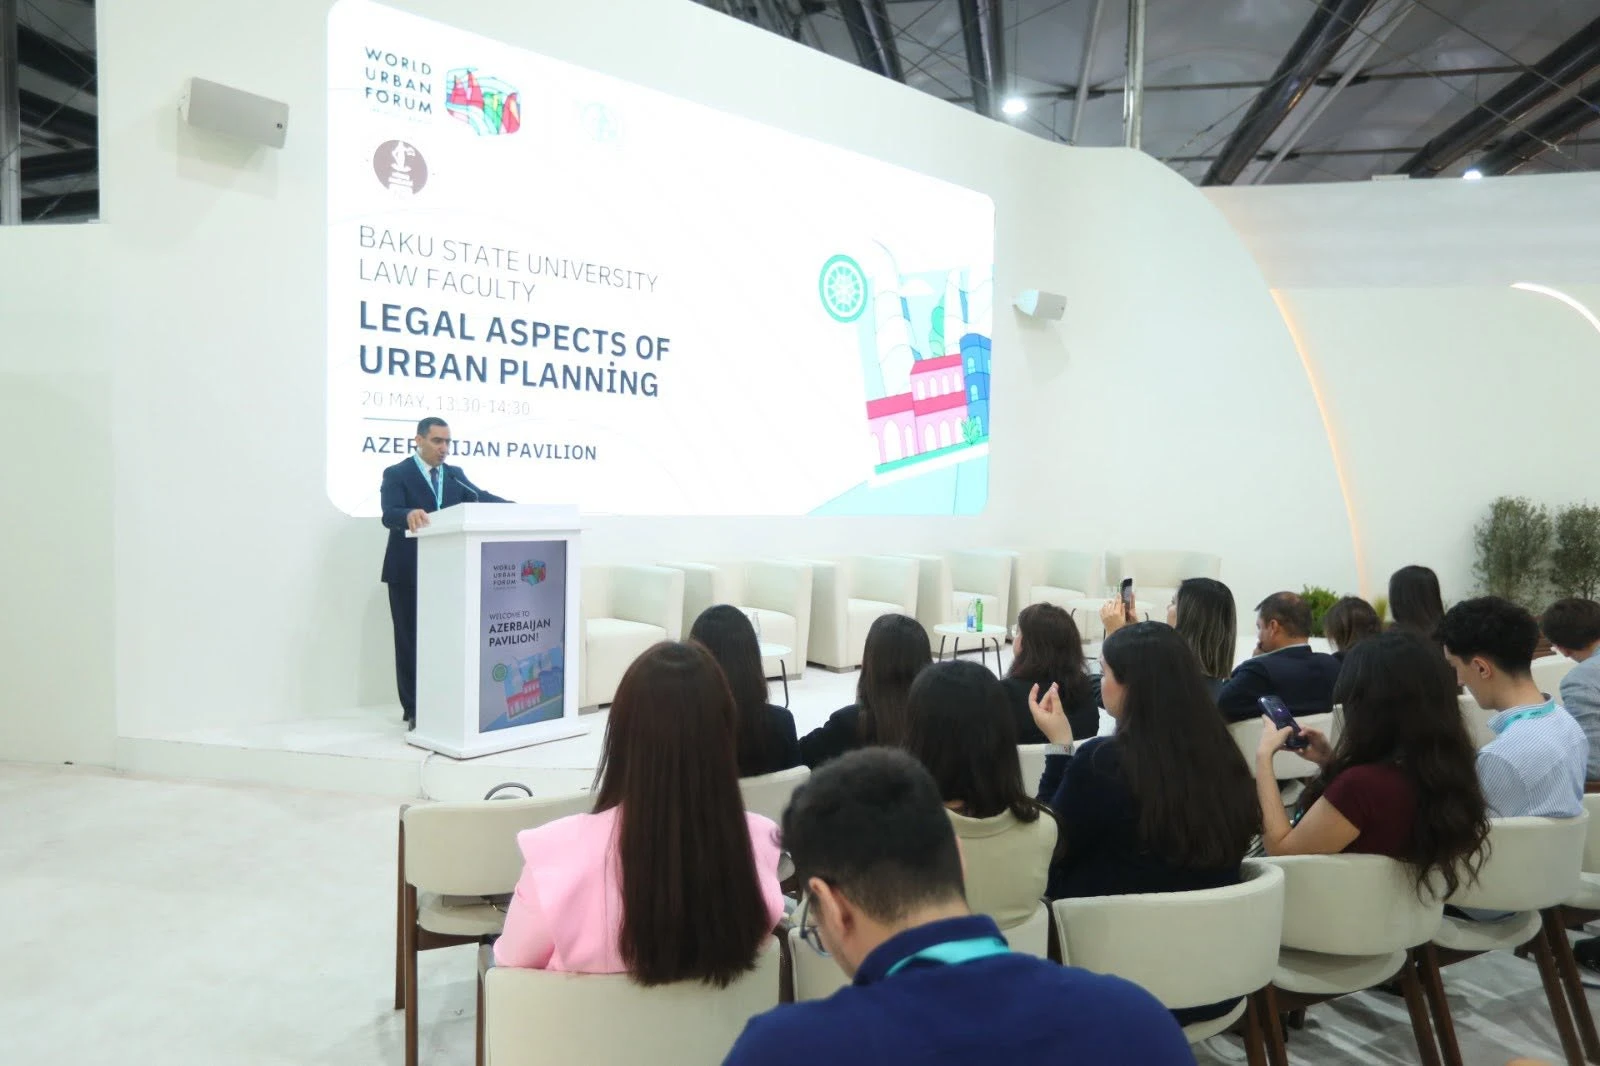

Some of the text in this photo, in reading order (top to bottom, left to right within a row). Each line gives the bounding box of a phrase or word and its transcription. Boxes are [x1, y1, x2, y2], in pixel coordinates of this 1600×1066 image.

[365, 46, 431, 75] WORLD
[365, 67, 431, 95] URBAN
[365, 87, 432, 115] FORUM
[360, 225, 658, 292] BAKU STATE UNIVERSITY
[360, 258, 536, 302] LAW FACULTY
[360, 300, 671, 361] LEGAL ASPECTS OF
[360, 344, 487, 383] URBAN
[361, 391, 383, 407] 20
[389, 392, 430, 411] MAY,
[362, 436, 596, 460] AZERIJAN PAVILION
[489, 612, 520, 620] WELCOME
[489, 619, 551, 634] AZERBAIJAN
[489, 633, 539, 647] PAVILION!
